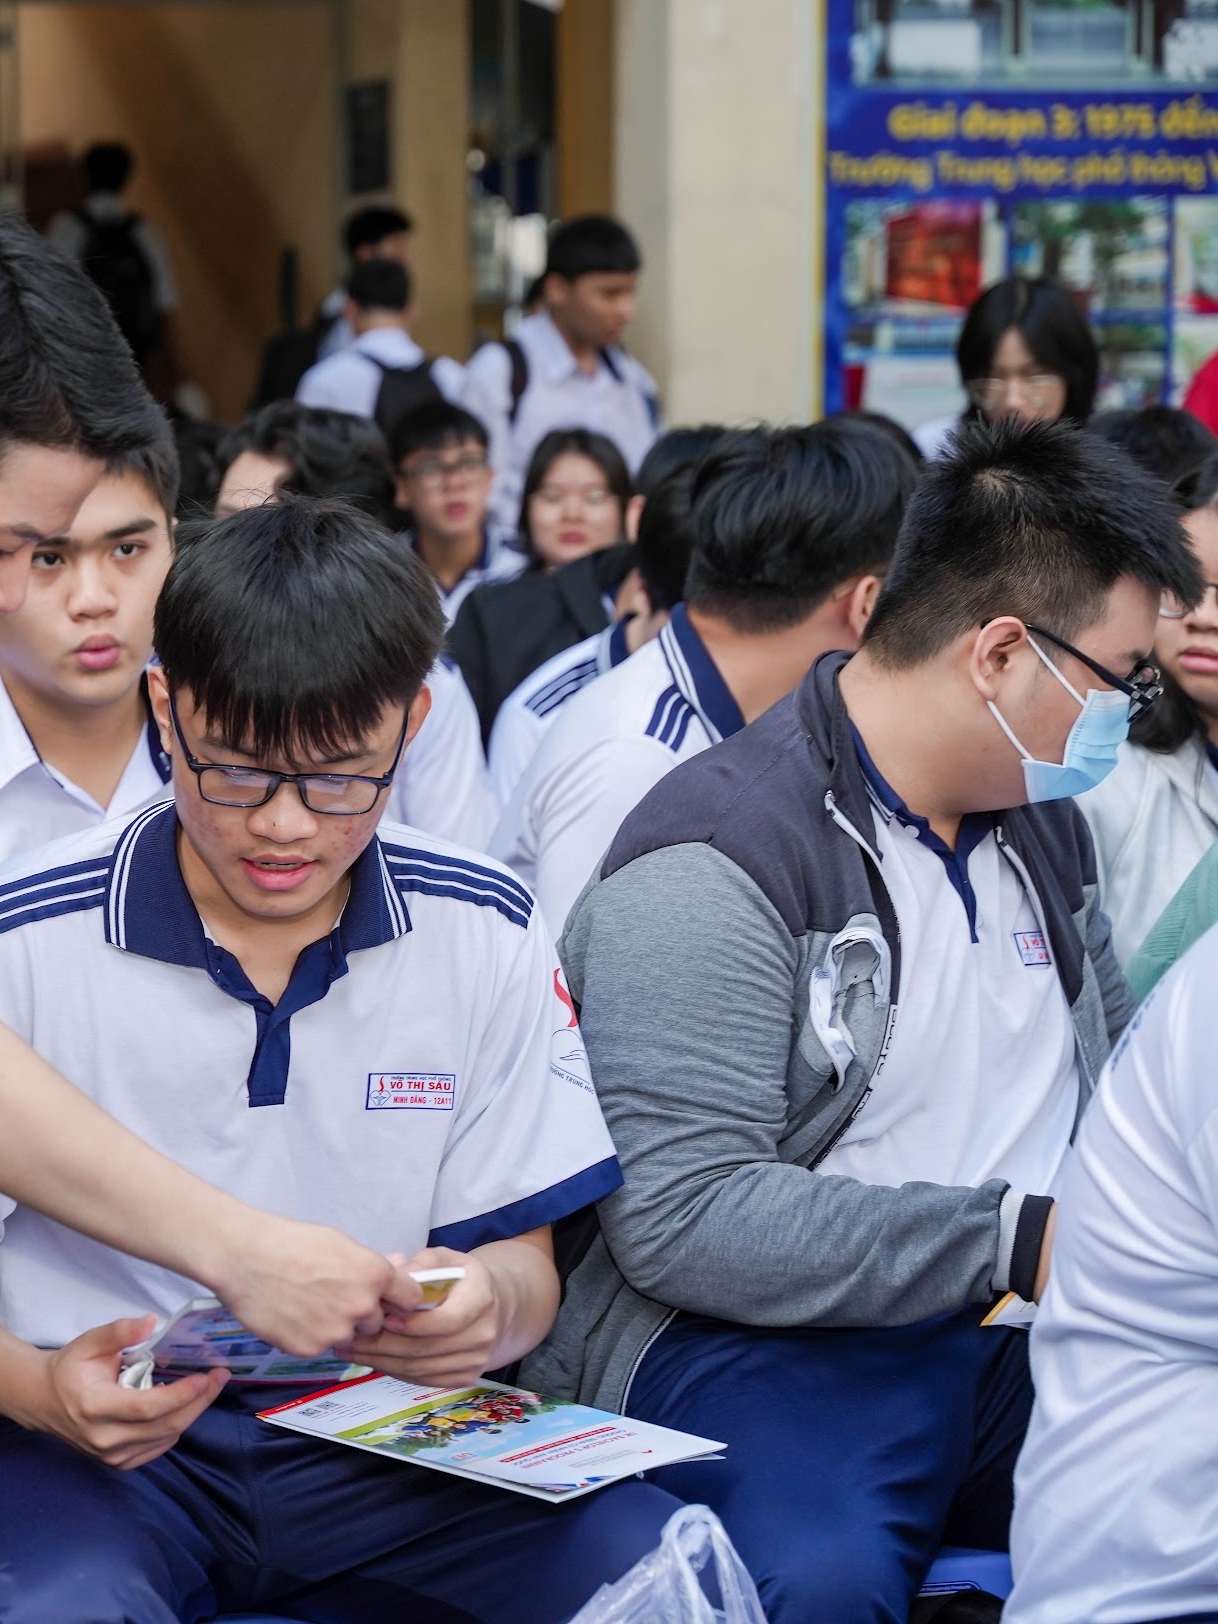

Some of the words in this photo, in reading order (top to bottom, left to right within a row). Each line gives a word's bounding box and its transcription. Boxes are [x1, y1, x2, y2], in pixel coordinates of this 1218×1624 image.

[889, 101, 956, 140] Giai
[1086, 103, 1155, 140] 1975
[938, 151, 1016, 193] Trung
[390, 1080, 403, 1089] VÕ
[407, 1081, 424, 1091] THỊ
[428, 1080, 451, 1090] SÁU
